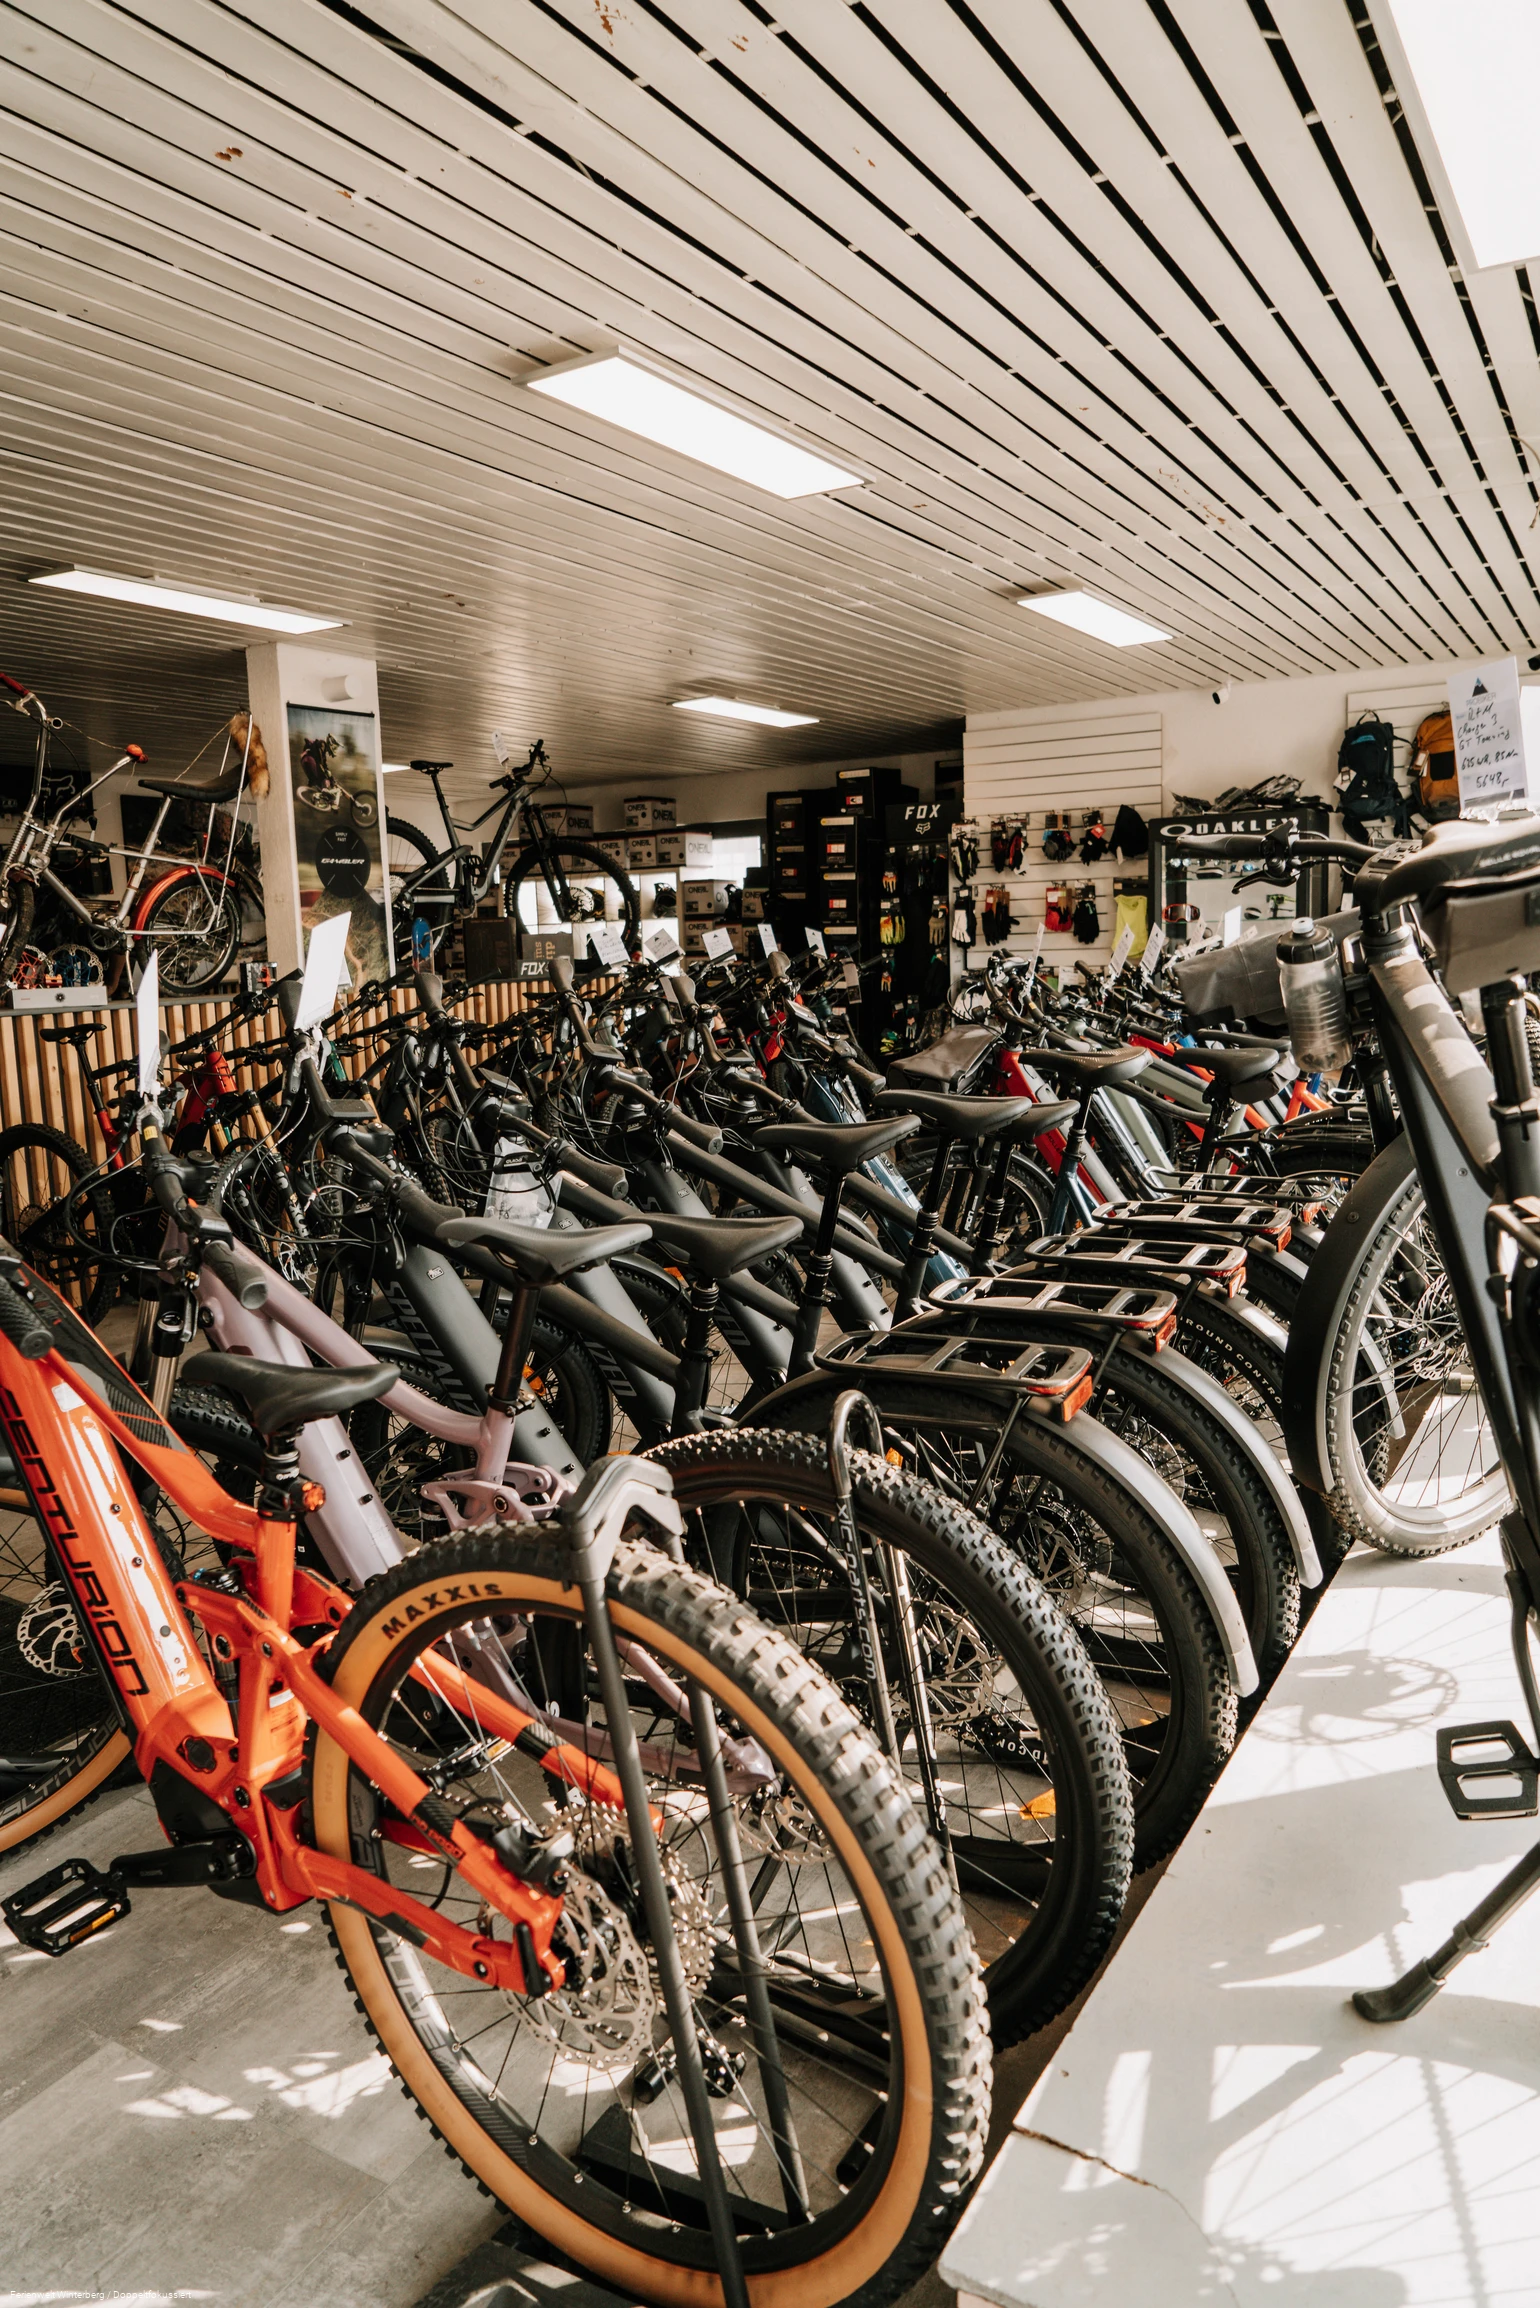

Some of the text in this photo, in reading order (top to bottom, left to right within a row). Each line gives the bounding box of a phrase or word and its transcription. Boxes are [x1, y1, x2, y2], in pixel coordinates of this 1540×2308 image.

[905, 804, 941, 820] FOX
[521, 962, 545, 976] FOX
[1180, 1316, 1234, 1352] ROUND
[382, 1583, 504, 1641] MAXXIS
